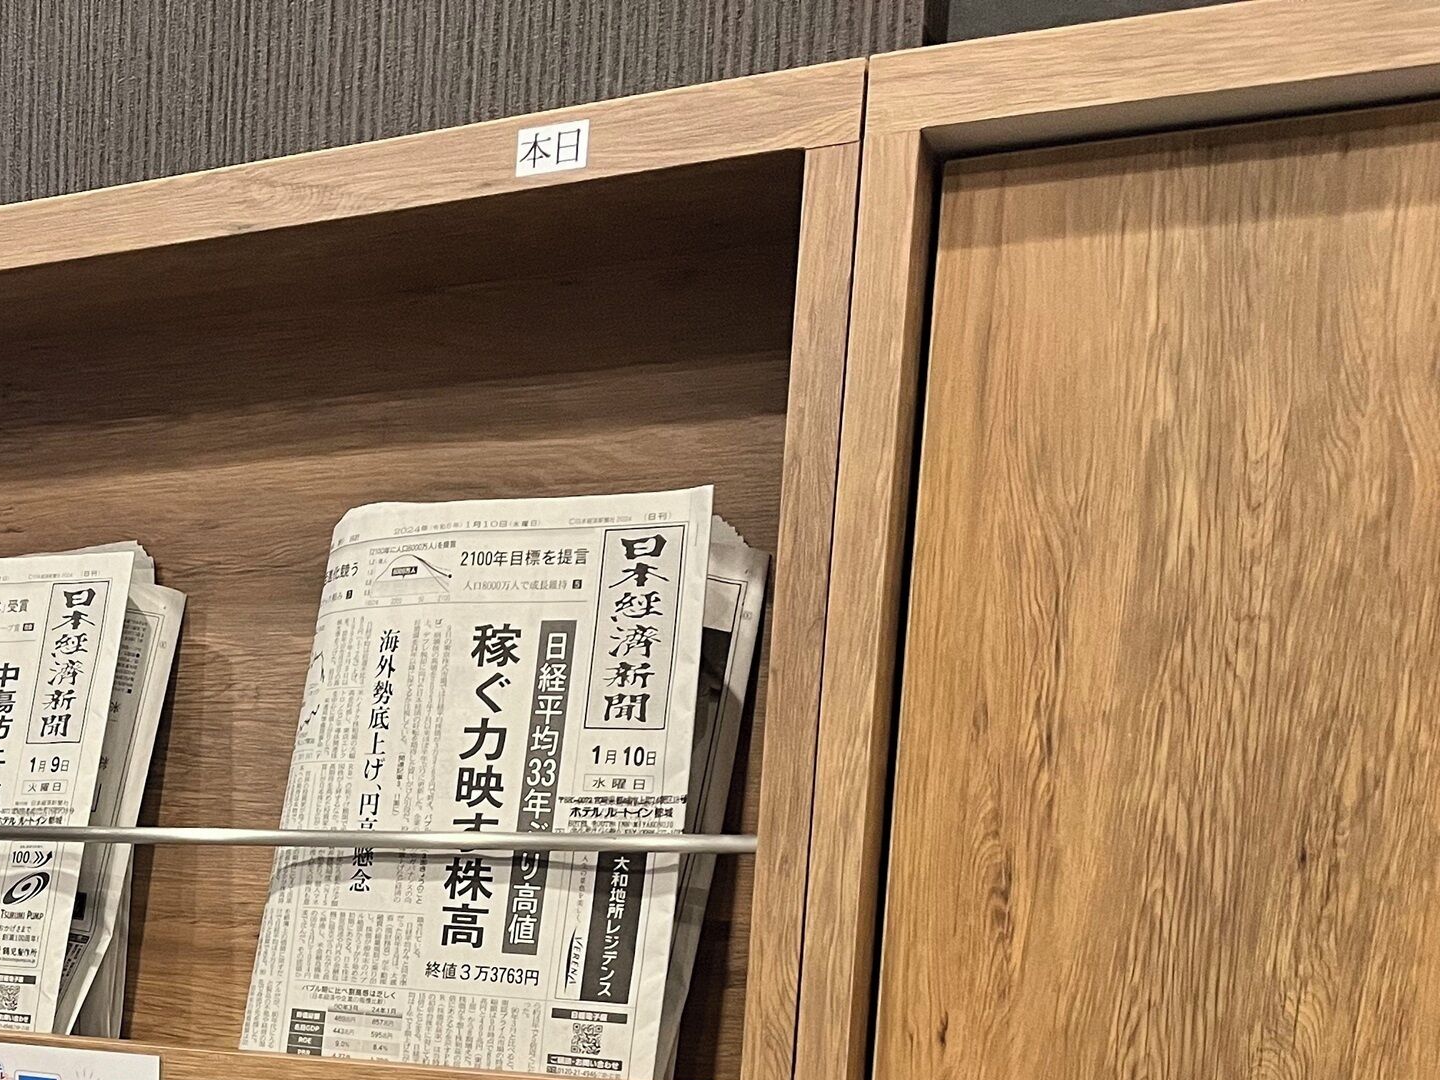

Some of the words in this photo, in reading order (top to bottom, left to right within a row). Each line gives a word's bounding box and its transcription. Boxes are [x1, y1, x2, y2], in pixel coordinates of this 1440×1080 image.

[519, 128, 581, 168] 本日
[460, 547, 590, 567] 2100年目標を提言
[30, 755, 70, 773] 1月9日
[592, 745, 656, 767] 1月10日
[27, 782, 62, 793] 火曜日
[592, 777, 646, 790] 水曜日
[569, 806, 601, 818] ホテル
[605, 806, 653, 818] ルートイン
[597, 855, 631, 997] 大和地所レジデンス
[425, 960, 540, 987] 終値3万3763円
